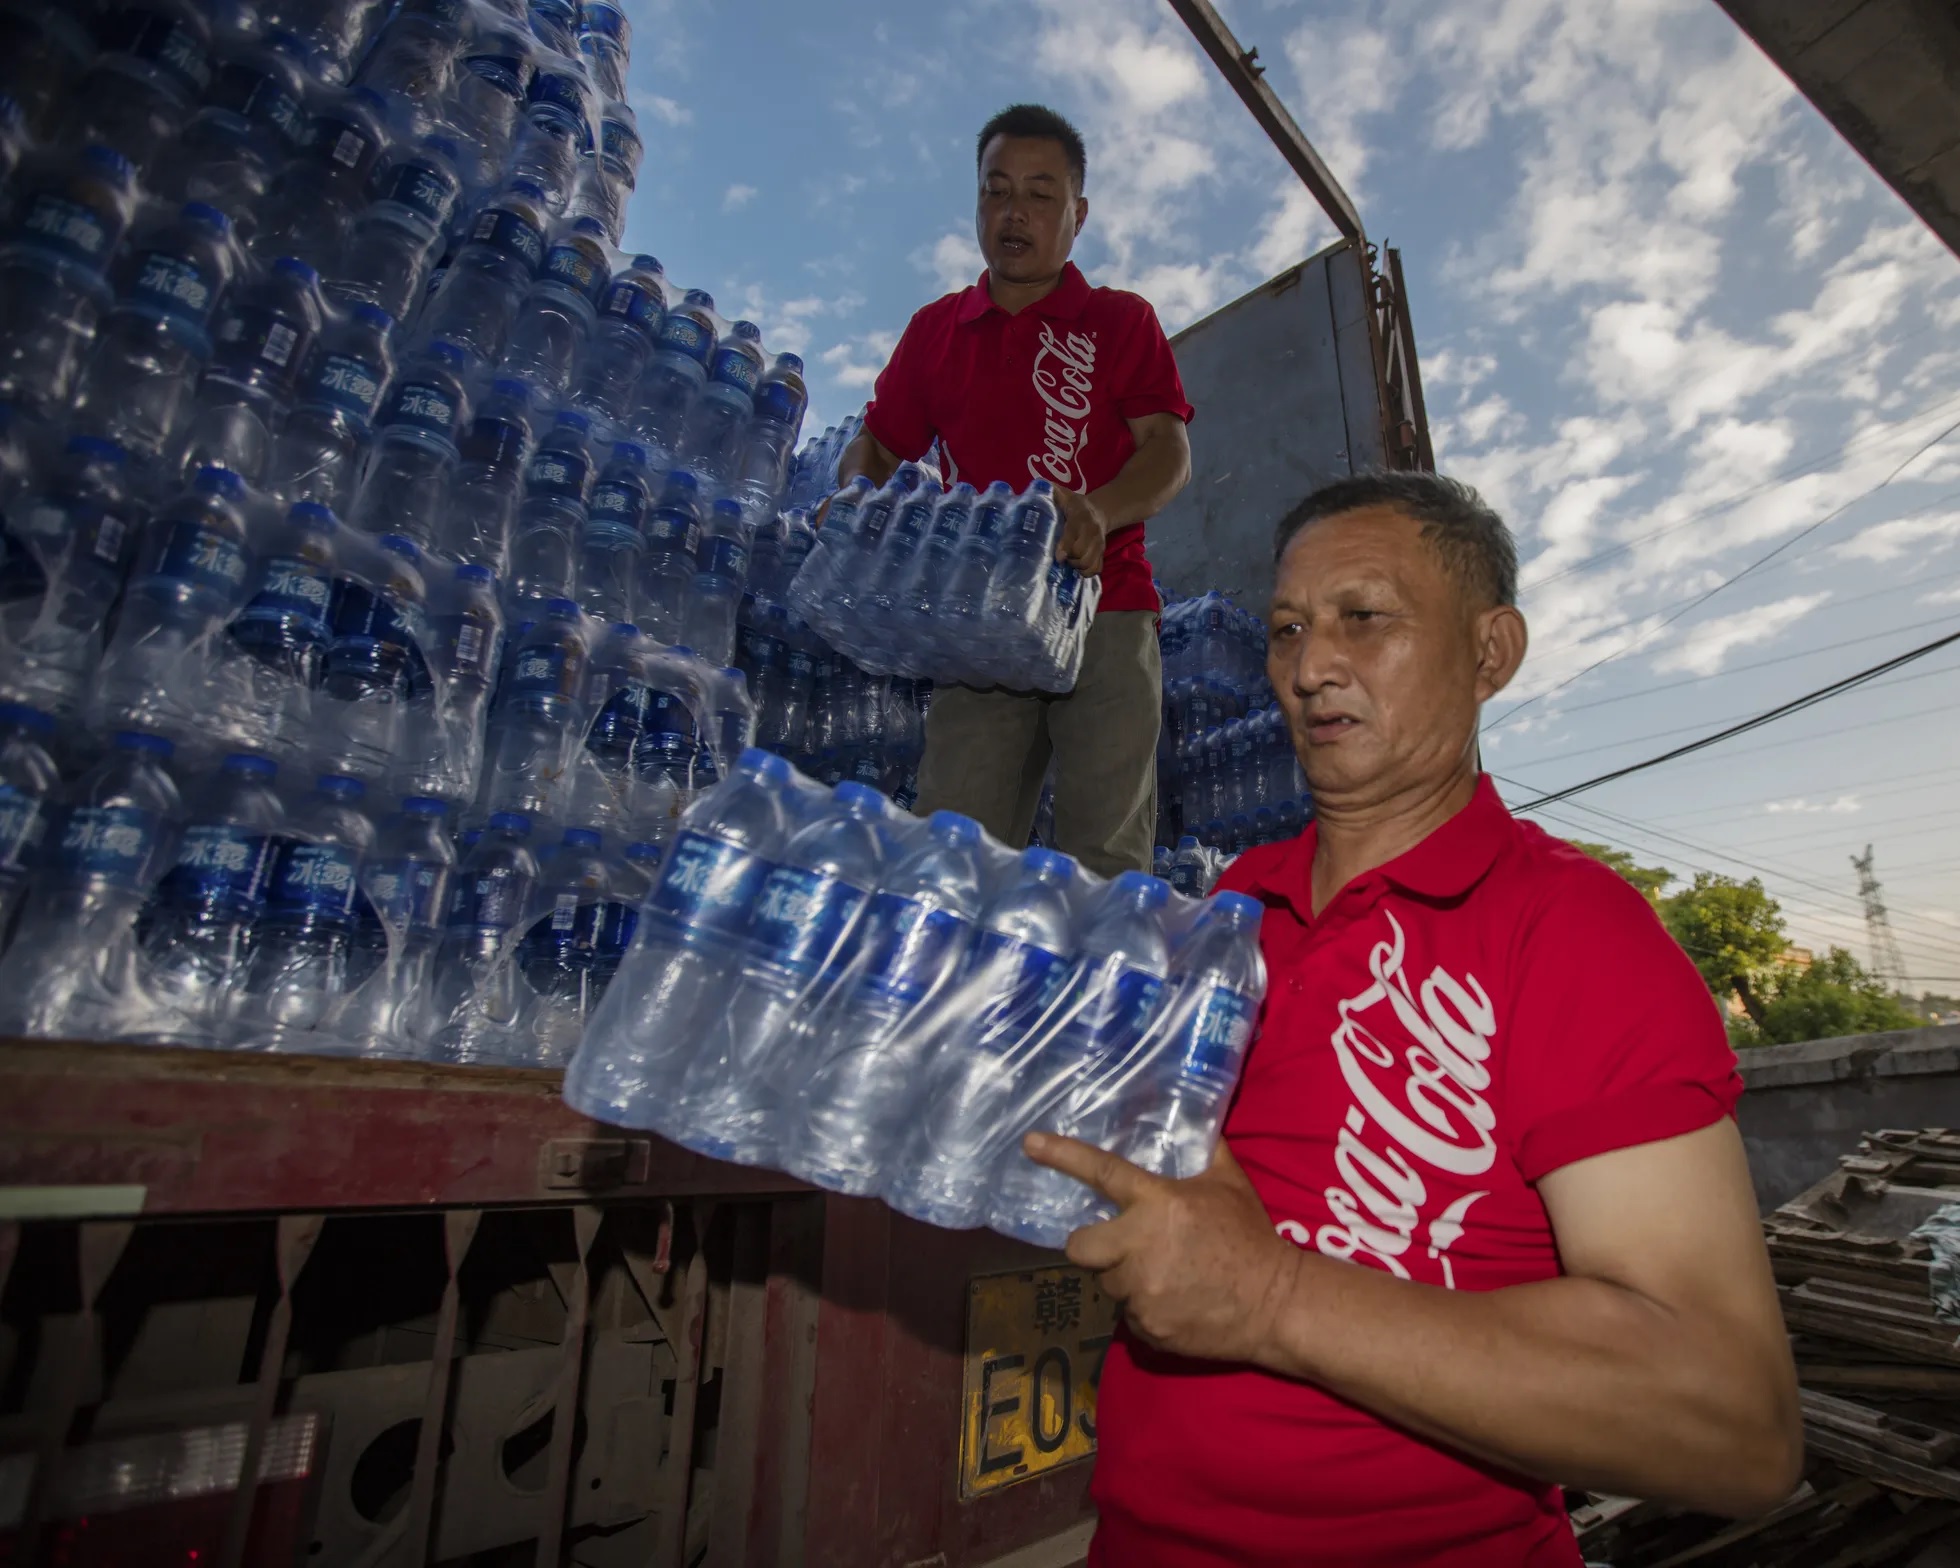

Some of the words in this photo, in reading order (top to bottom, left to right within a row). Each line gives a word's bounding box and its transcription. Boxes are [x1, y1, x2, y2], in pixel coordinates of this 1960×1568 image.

[319, 365, 378, 404] 冰露
[399, 394, 451, 425] 冰露
[1274, 907, 1498, 1281] oca-Cola
